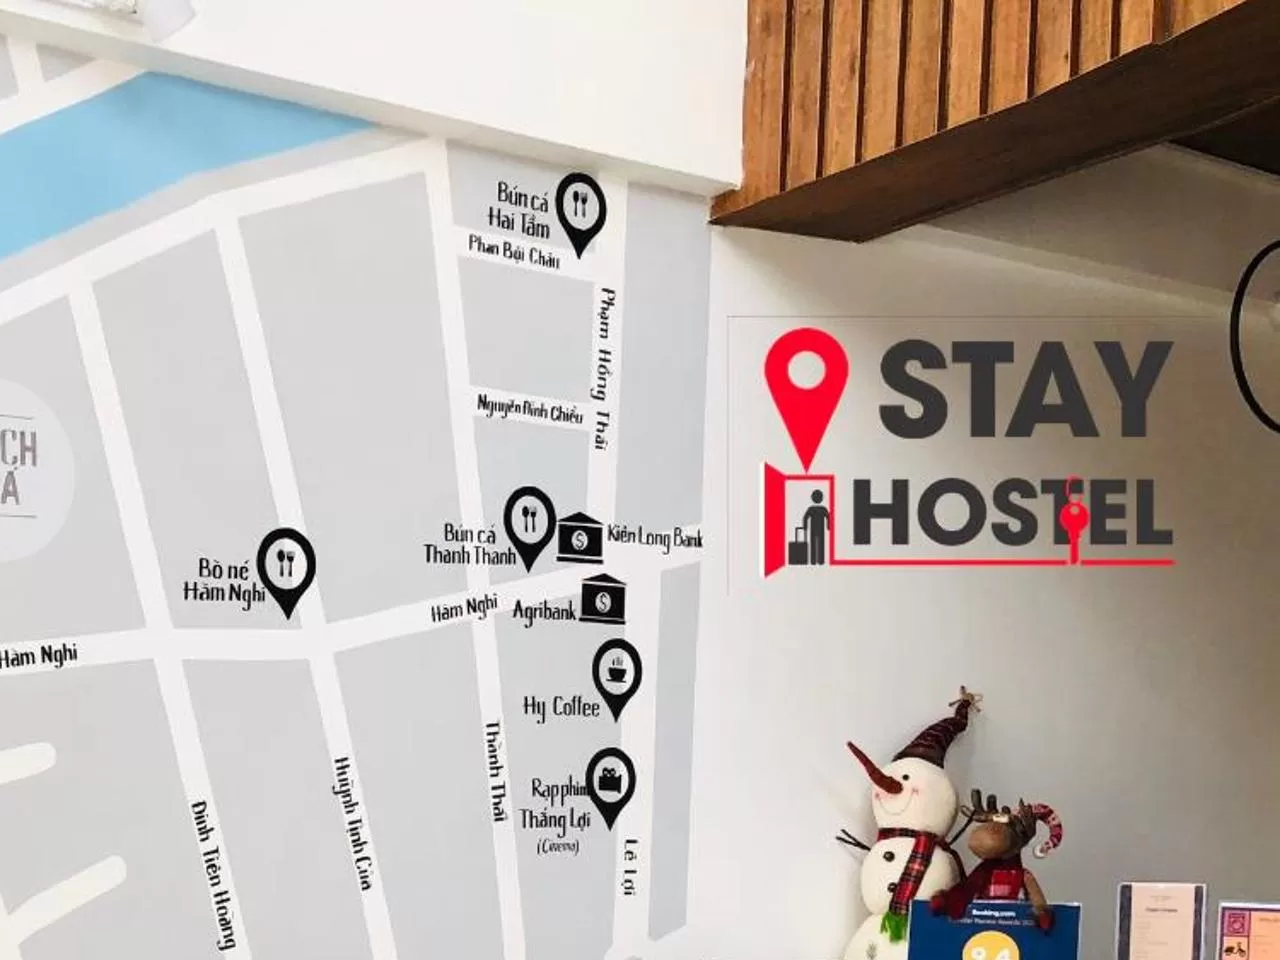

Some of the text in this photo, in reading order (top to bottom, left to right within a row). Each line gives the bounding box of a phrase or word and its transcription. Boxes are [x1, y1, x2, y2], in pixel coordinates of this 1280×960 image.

[498, 181, 548, 212] Bún cá
[488, 206, 514, 230] Hai
[468, 234, 499, 255] Phan
[503, 242, 525, 264] Bội
[597, 287, 616, 339] Phạm
[595, 412, 610, 451] Thái
[444, 523, 496, 544] Bún cá
[607, 525, 704, 555] Kiên Long Bank
[199, 557, 249, 581] Bò né
[474, 546, 517, 566] Thanh
[229, 582, 266, 611] Nghi
[466, 593, 498, 620] Nghi
[513, 599, 577, 629] Agribank
[40, 643, 78, 668] Nghi
[523, 695, 600, 724] Hy Coffee
[624, 838, 638, 861] Lê
